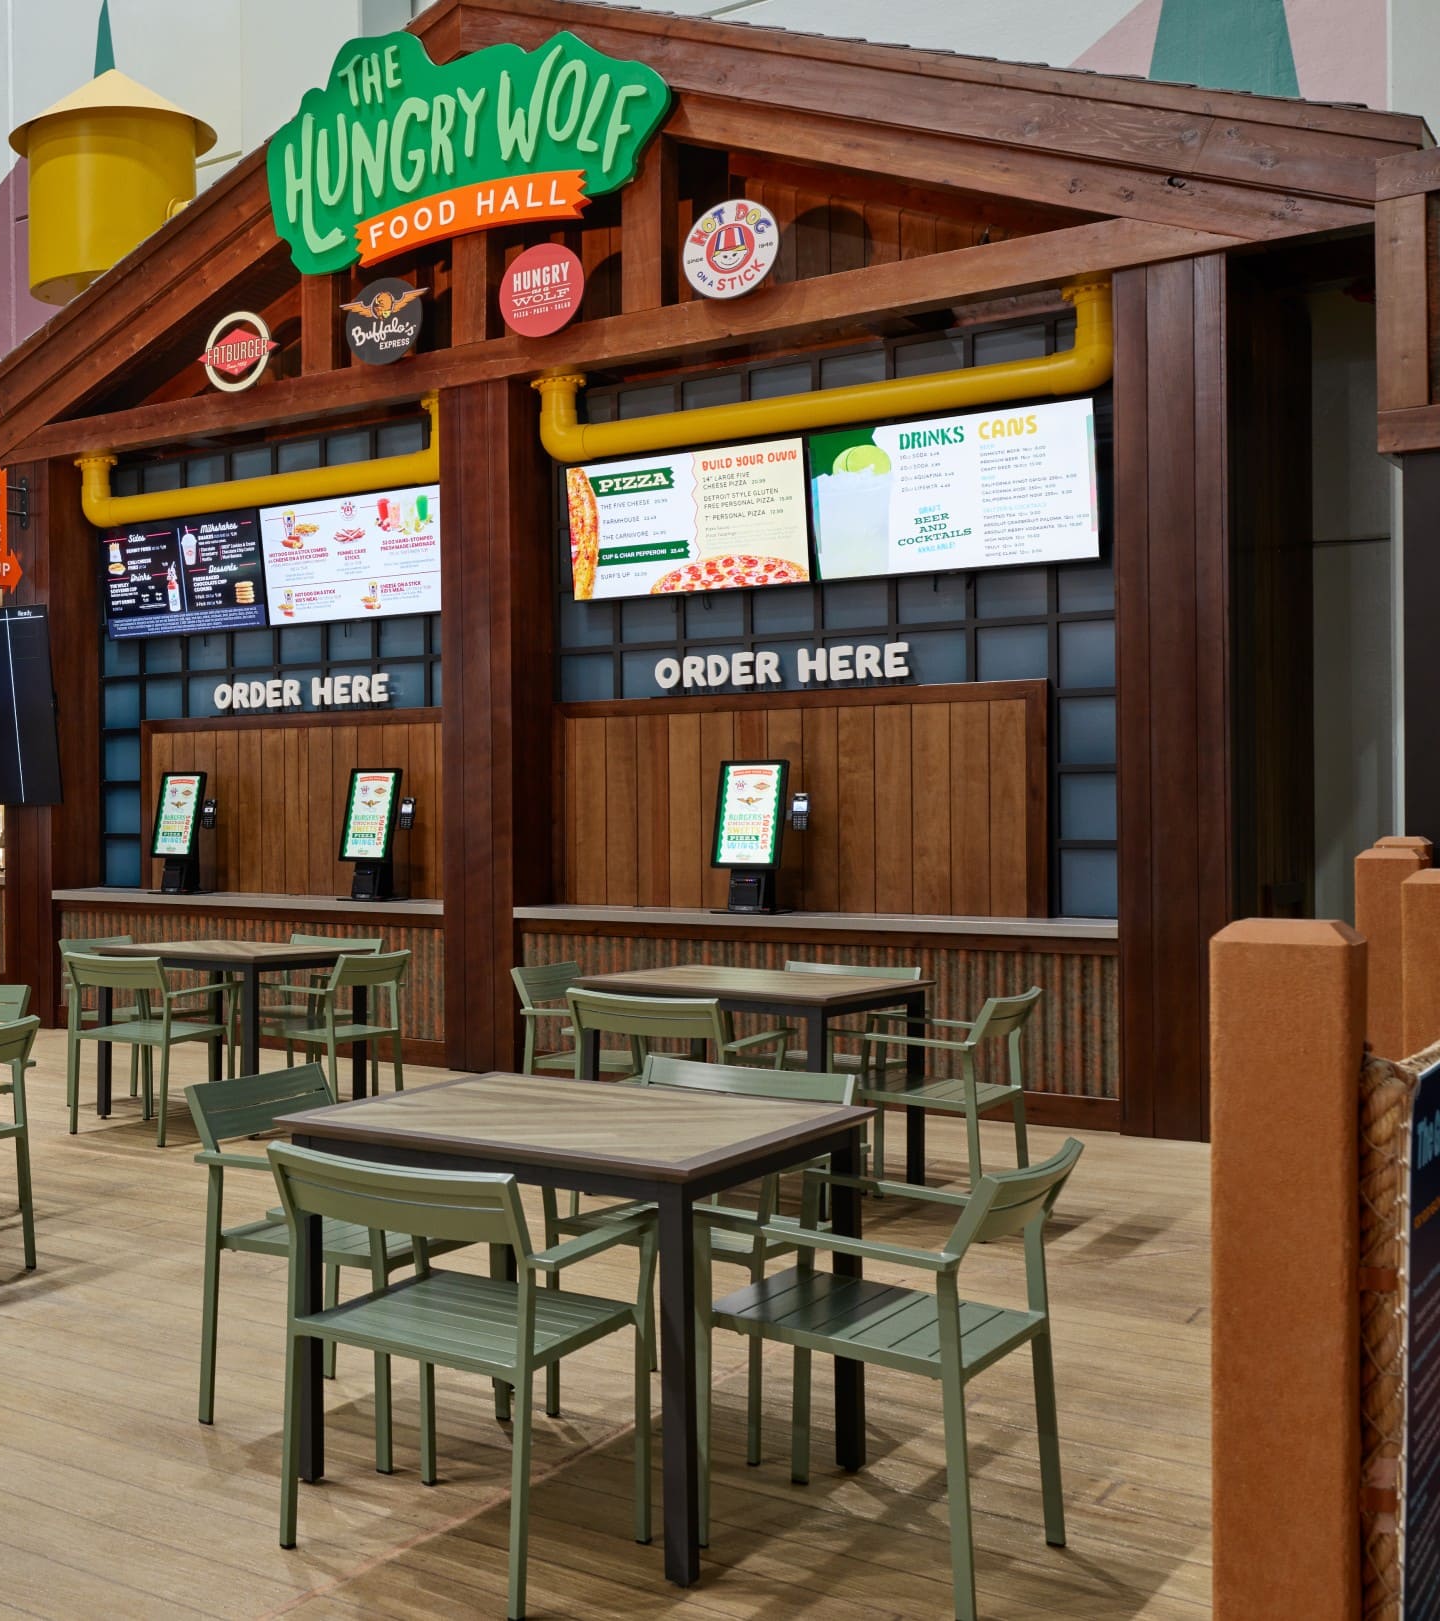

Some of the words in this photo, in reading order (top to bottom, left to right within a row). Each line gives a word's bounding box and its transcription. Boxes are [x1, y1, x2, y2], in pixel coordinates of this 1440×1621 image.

[338, 45, 402, 108] THE
[285, 86, 486, 254] HUNGRY
[498, 45, 647, 173] WOLF
[369, 199, 455, 249] FOOD
[477, 180, 566, 230] HALL
[690, 207, 724, 246] HOT
[735, 203, 772, 234] DOG
[514, 262, 569, 292] HUNGRY
[697, 272, 708, 282] ON
[717, 259, 765, 291] STICK
[512, 288, 569, 307] WOLF
[533, 306, 548, 315] PASTA
[555, 301, 570, 310] SALAD
[352, 317, 414, 346] Buffalo's
[208, 337, 268, 366] FATBURGER
[380, 338, 410, 350] EXPRESS
[899, 426, 964, 450] DRINKS
[978, 415, 1038, 440] CANS
[702, 458, 732, 471] BUILD
[736, 454, 763, 467] YOUR
[768, 450, 797, 463] OWN
[598, 472, 669, 493] PIZZA
[753, 488, 778, 496] GLUTEN
[603, 516, 640, 524] FARMHOUSE
[712, 512, 745, 520] PERSONAL
[914, 512, 950, 524] BEER
[200, 522, 238, 533] Milkshakes
[615, 531, 648, 539] CARNIVORE
[898, 528, 972, 546] COCKTAILS
[920, 523, 947, 533] AND
[128, 534, 146, 543] Sides
[130, 573, 152, 582] Drinks
[208, 563, 238, 573] Desserts
[601, 572, 620, 580] SURF'S
[654, 652, 782, 688] ORDER
[797, 642, 909, 682] HERE
[214, 679, 302, 709] ORDER
[312, 673, 389, 706] HERE
[761, 814, 771, 849] SNACKS
